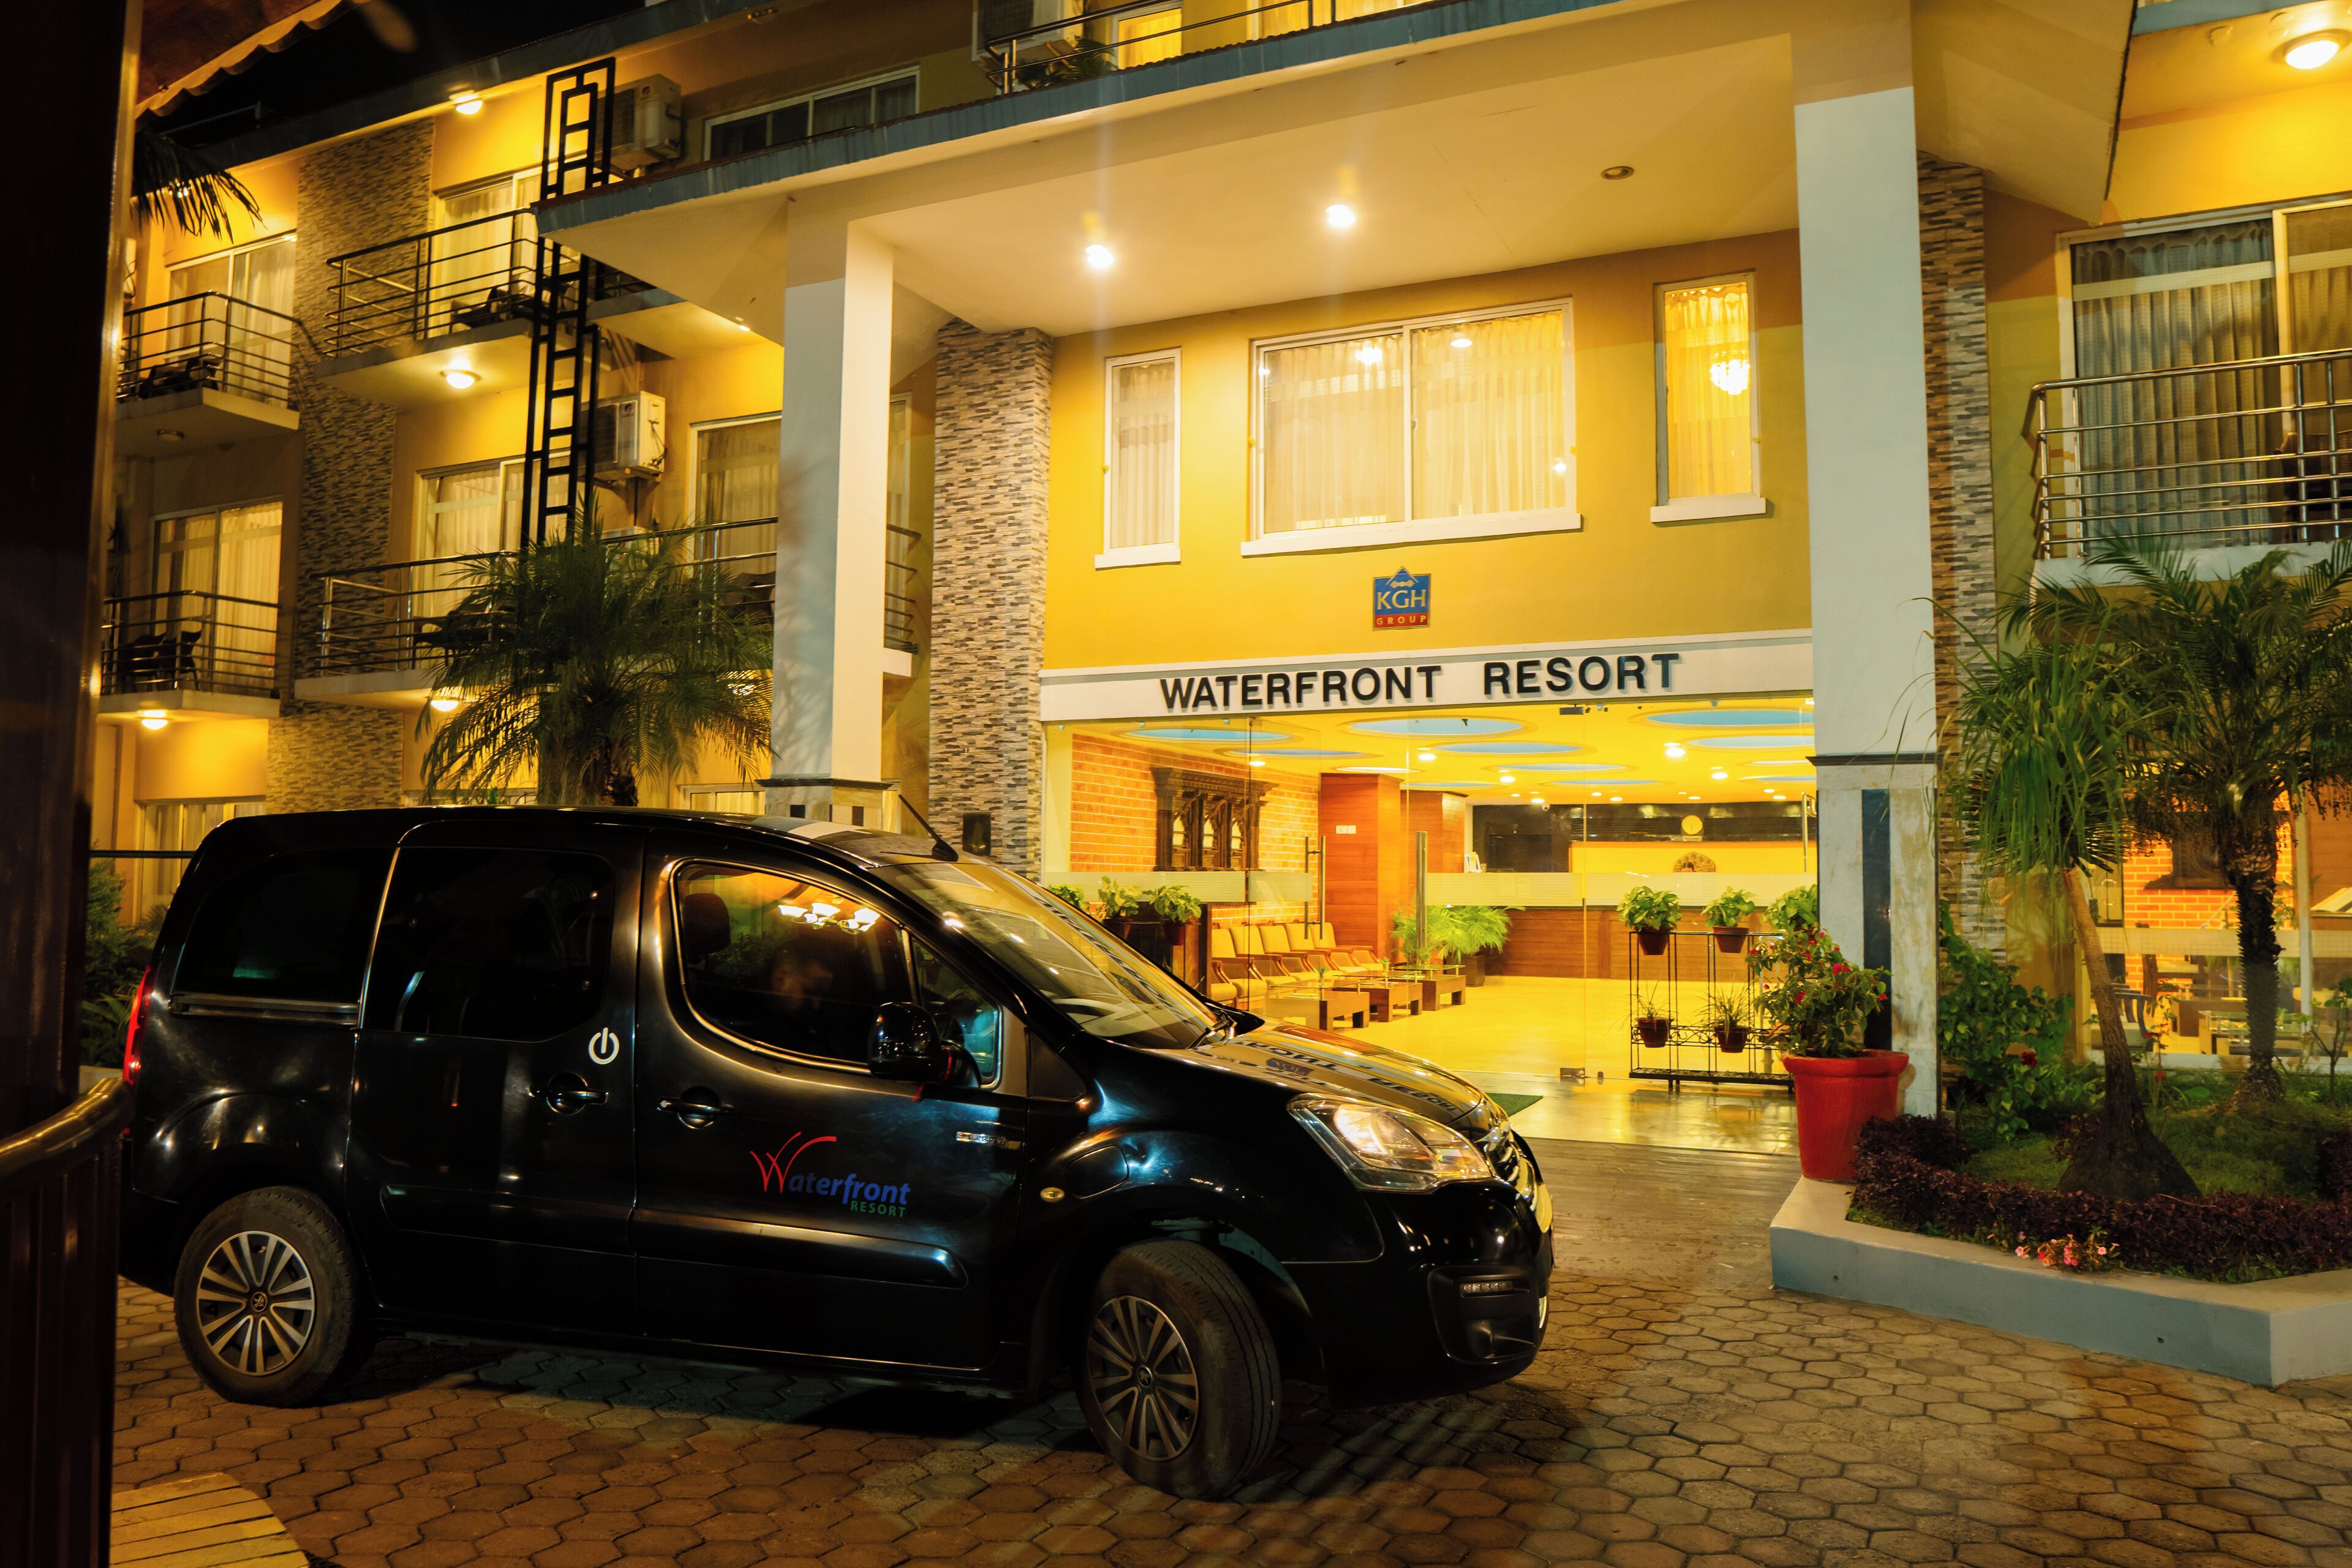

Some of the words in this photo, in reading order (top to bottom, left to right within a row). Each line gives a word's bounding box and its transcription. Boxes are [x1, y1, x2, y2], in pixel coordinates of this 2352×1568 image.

[1376, 589, 1427, 610] KGH
[1376, 615, 1427, 625] GROUP
[1159, 665, 1442, 709] WATERFRONT
[1483, 653, 1679, 695] RESORT
[750, 1131, 911, 1204] Waterfront
[850, 1200, 906, 1218] RESORT
